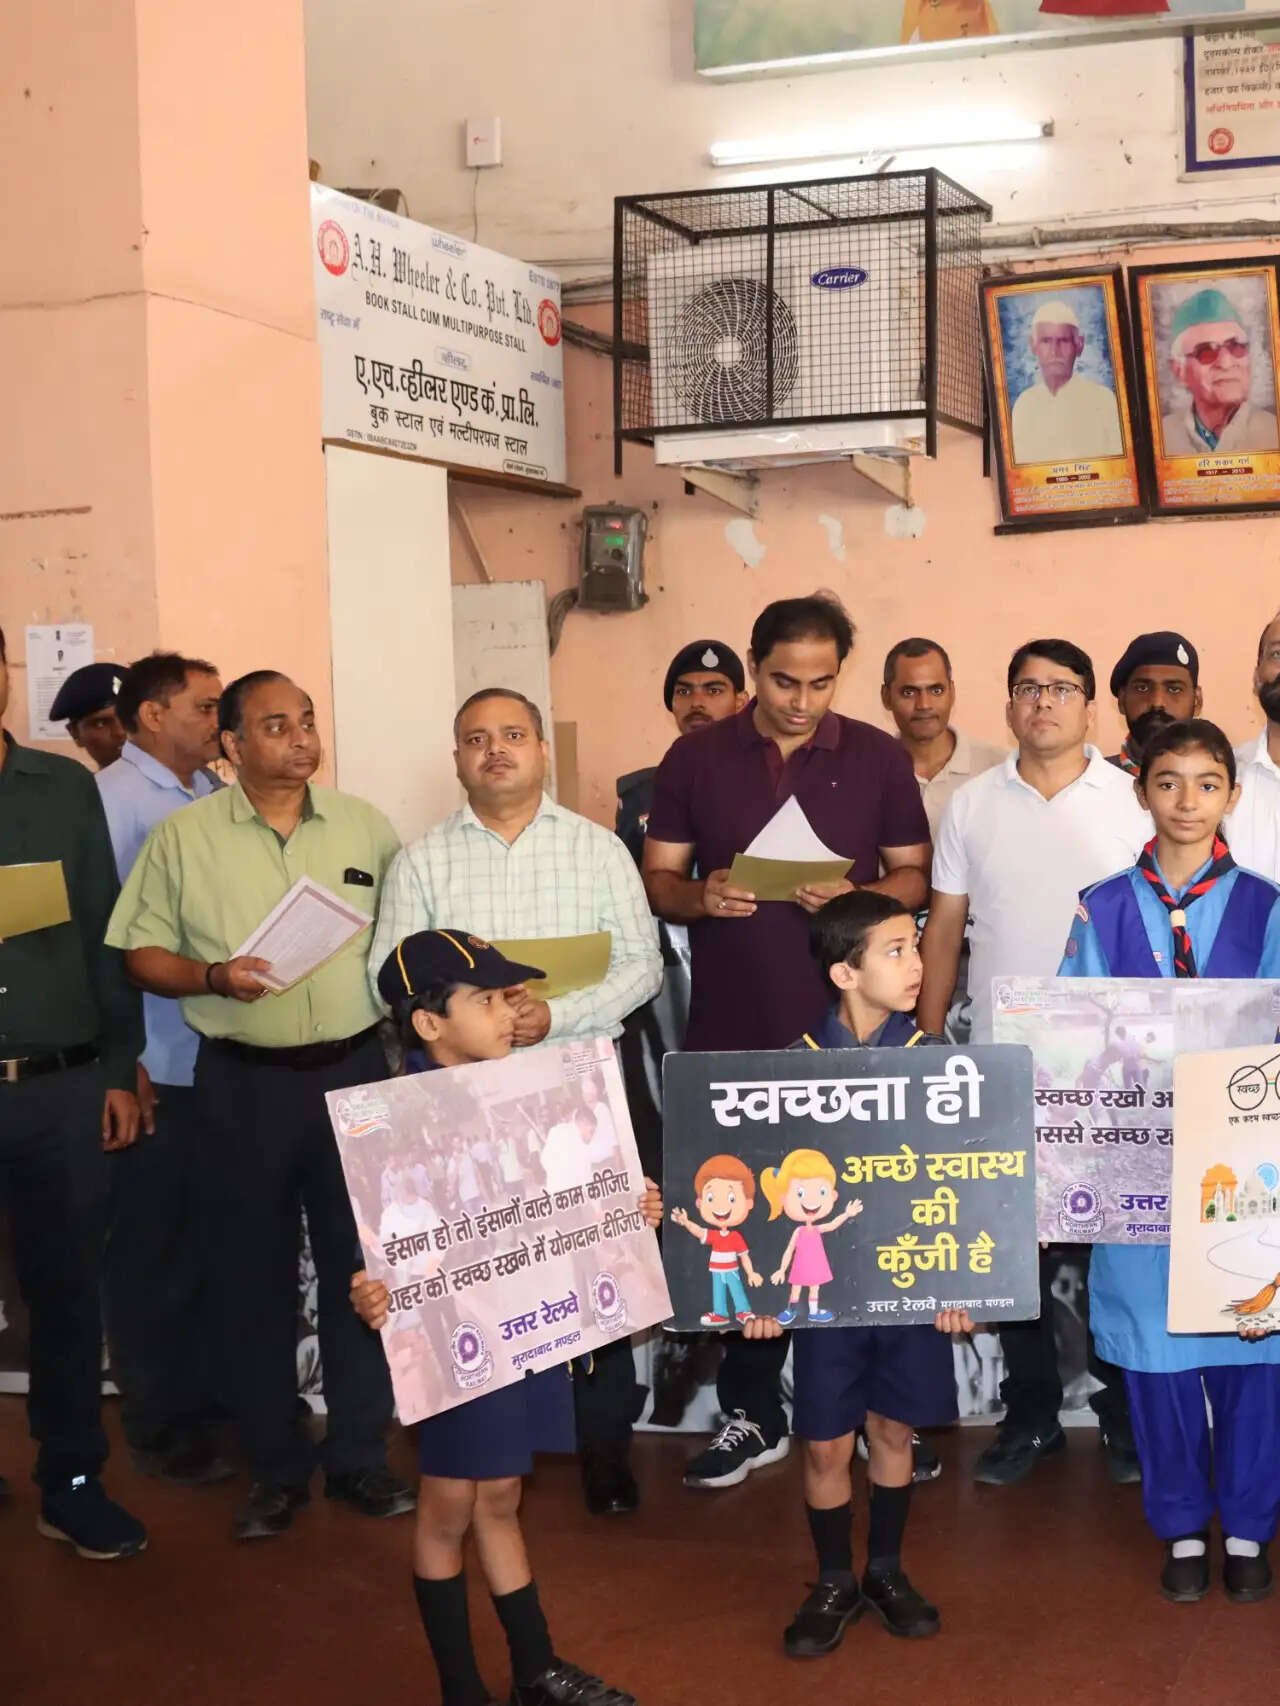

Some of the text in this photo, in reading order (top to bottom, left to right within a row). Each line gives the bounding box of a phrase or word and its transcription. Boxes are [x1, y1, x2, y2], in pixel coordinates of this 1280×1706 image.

[392, 247, 441, 297] Wheeler
[445, 267, 457, 302] &
[461, 272, 482, 308] Co.
[485, 279, 510, 321] Pvt.
[513, 288, 536, 328] Ltd.
[816, 268, 864, 287] Carrier
[365, 290, 527, 353] BOOK STALL CUM MULTIPURPOSE STALL
[369, 403, 529, 457] बुक स्टाल एवं मल्टीपरपज स्टाल
[709, 1054, 985, 1127] स्वच्छता ही
[1035, 1088, 1095, 1109] स्वच्छ
[1099, 1083, 1150, 1109] रखो
[1090, 1126, 1151, 1147] स्वच्छ
[841, 1143, 1027, 1184] अच्छे स्वास्थ
[382, 1166, 632, 1268] इंसान हो तो इंसानों वाले काम कीजिए
[911, 1186, 960, 1227] की
[1119, 1193, 1169, 1211] उत्तर
[1126, 1222, 1171, 1237] मुरादाबा
[426, 1269, 450, 1300] को
[452, 1256, 493, 1294] स्वच्छ
[494, 1241, 532, 1279] रखने
[532, 1232, 548, 1264] में
[549, 1222, 601, 1263] योगदान
[875, 1229, 997, 1289] कुँजी है
[499, 1289, 581, 1342] उत्तर रेलवे
[866, 1299, 900, 1313] उत्तर
[902, 1295, 937, 1312] रेलवे
[985, 1297, 1015, 1309] मण्डल
[510, 1329, 582, 1371] मुरादाबाद मण्डल
